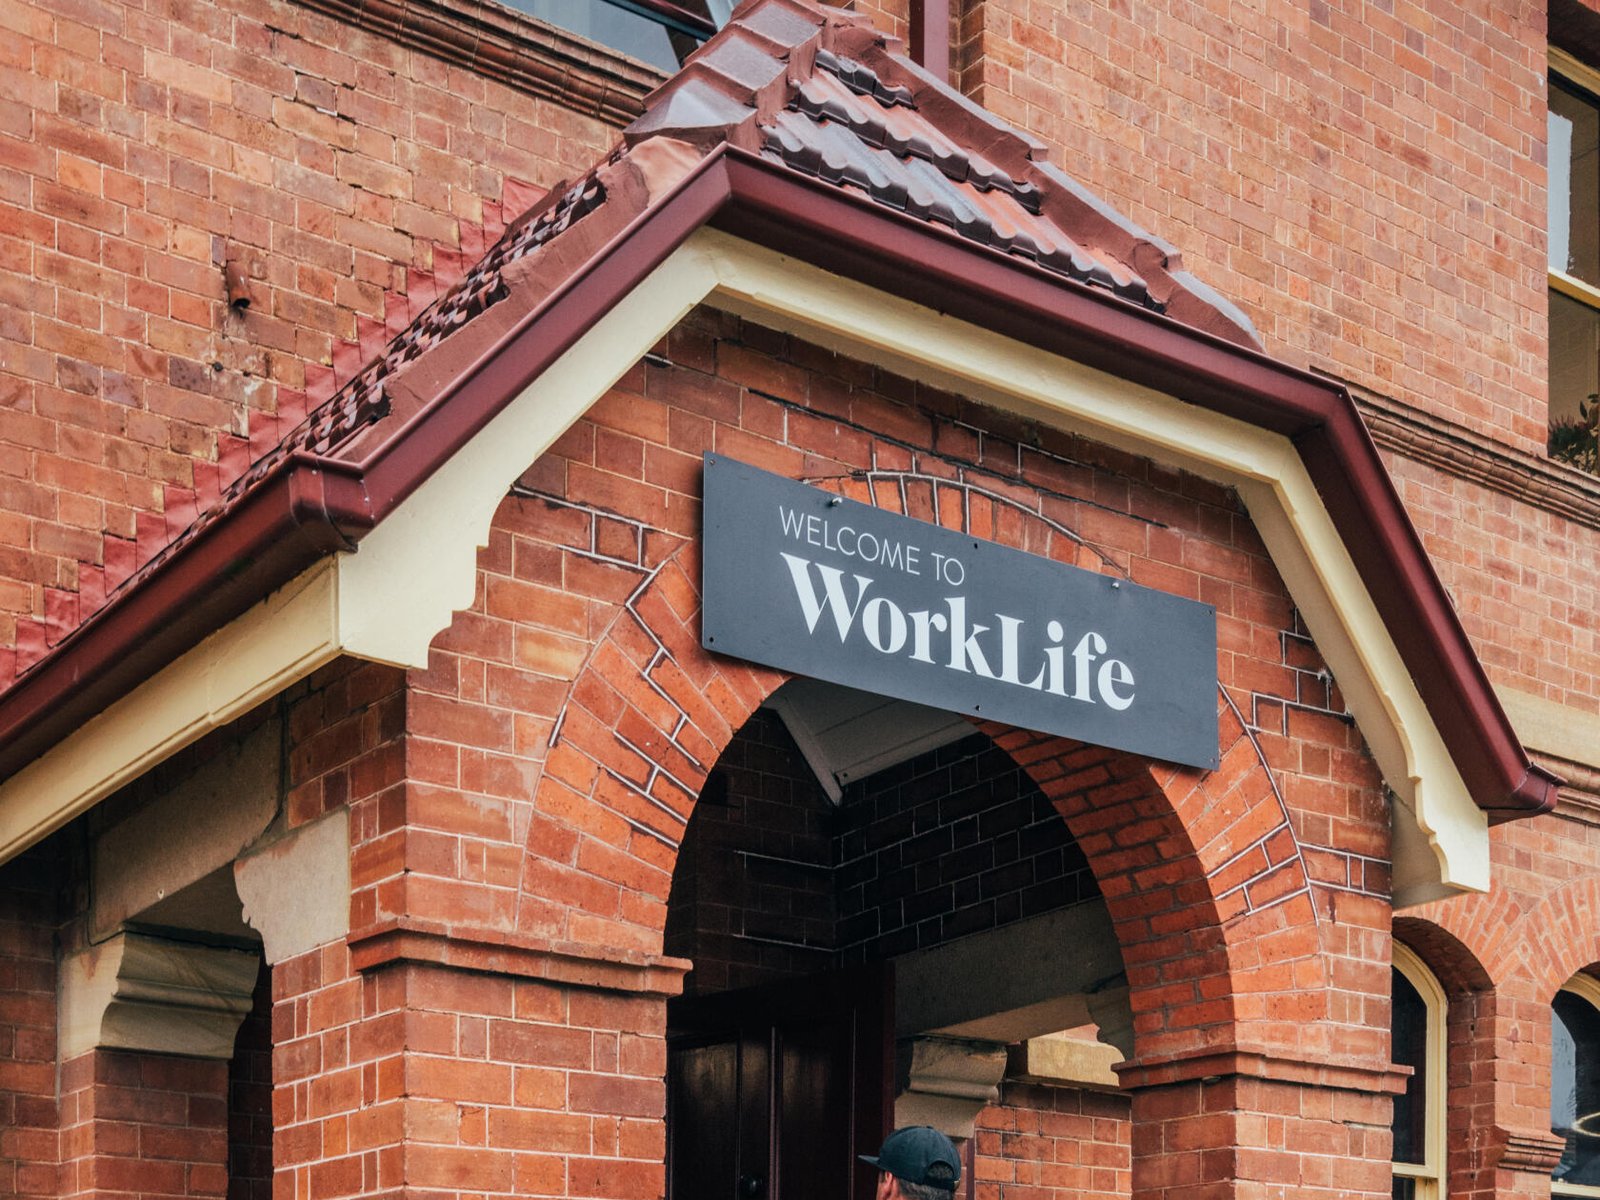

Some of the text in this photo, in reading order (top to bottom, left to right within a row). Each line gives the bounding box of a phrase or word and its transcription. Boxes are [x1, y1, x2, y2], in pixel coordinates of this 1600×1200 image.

[779, 506, 965, 587] WELCOME TO
[780, 552, 1135, 711] WorkLife
